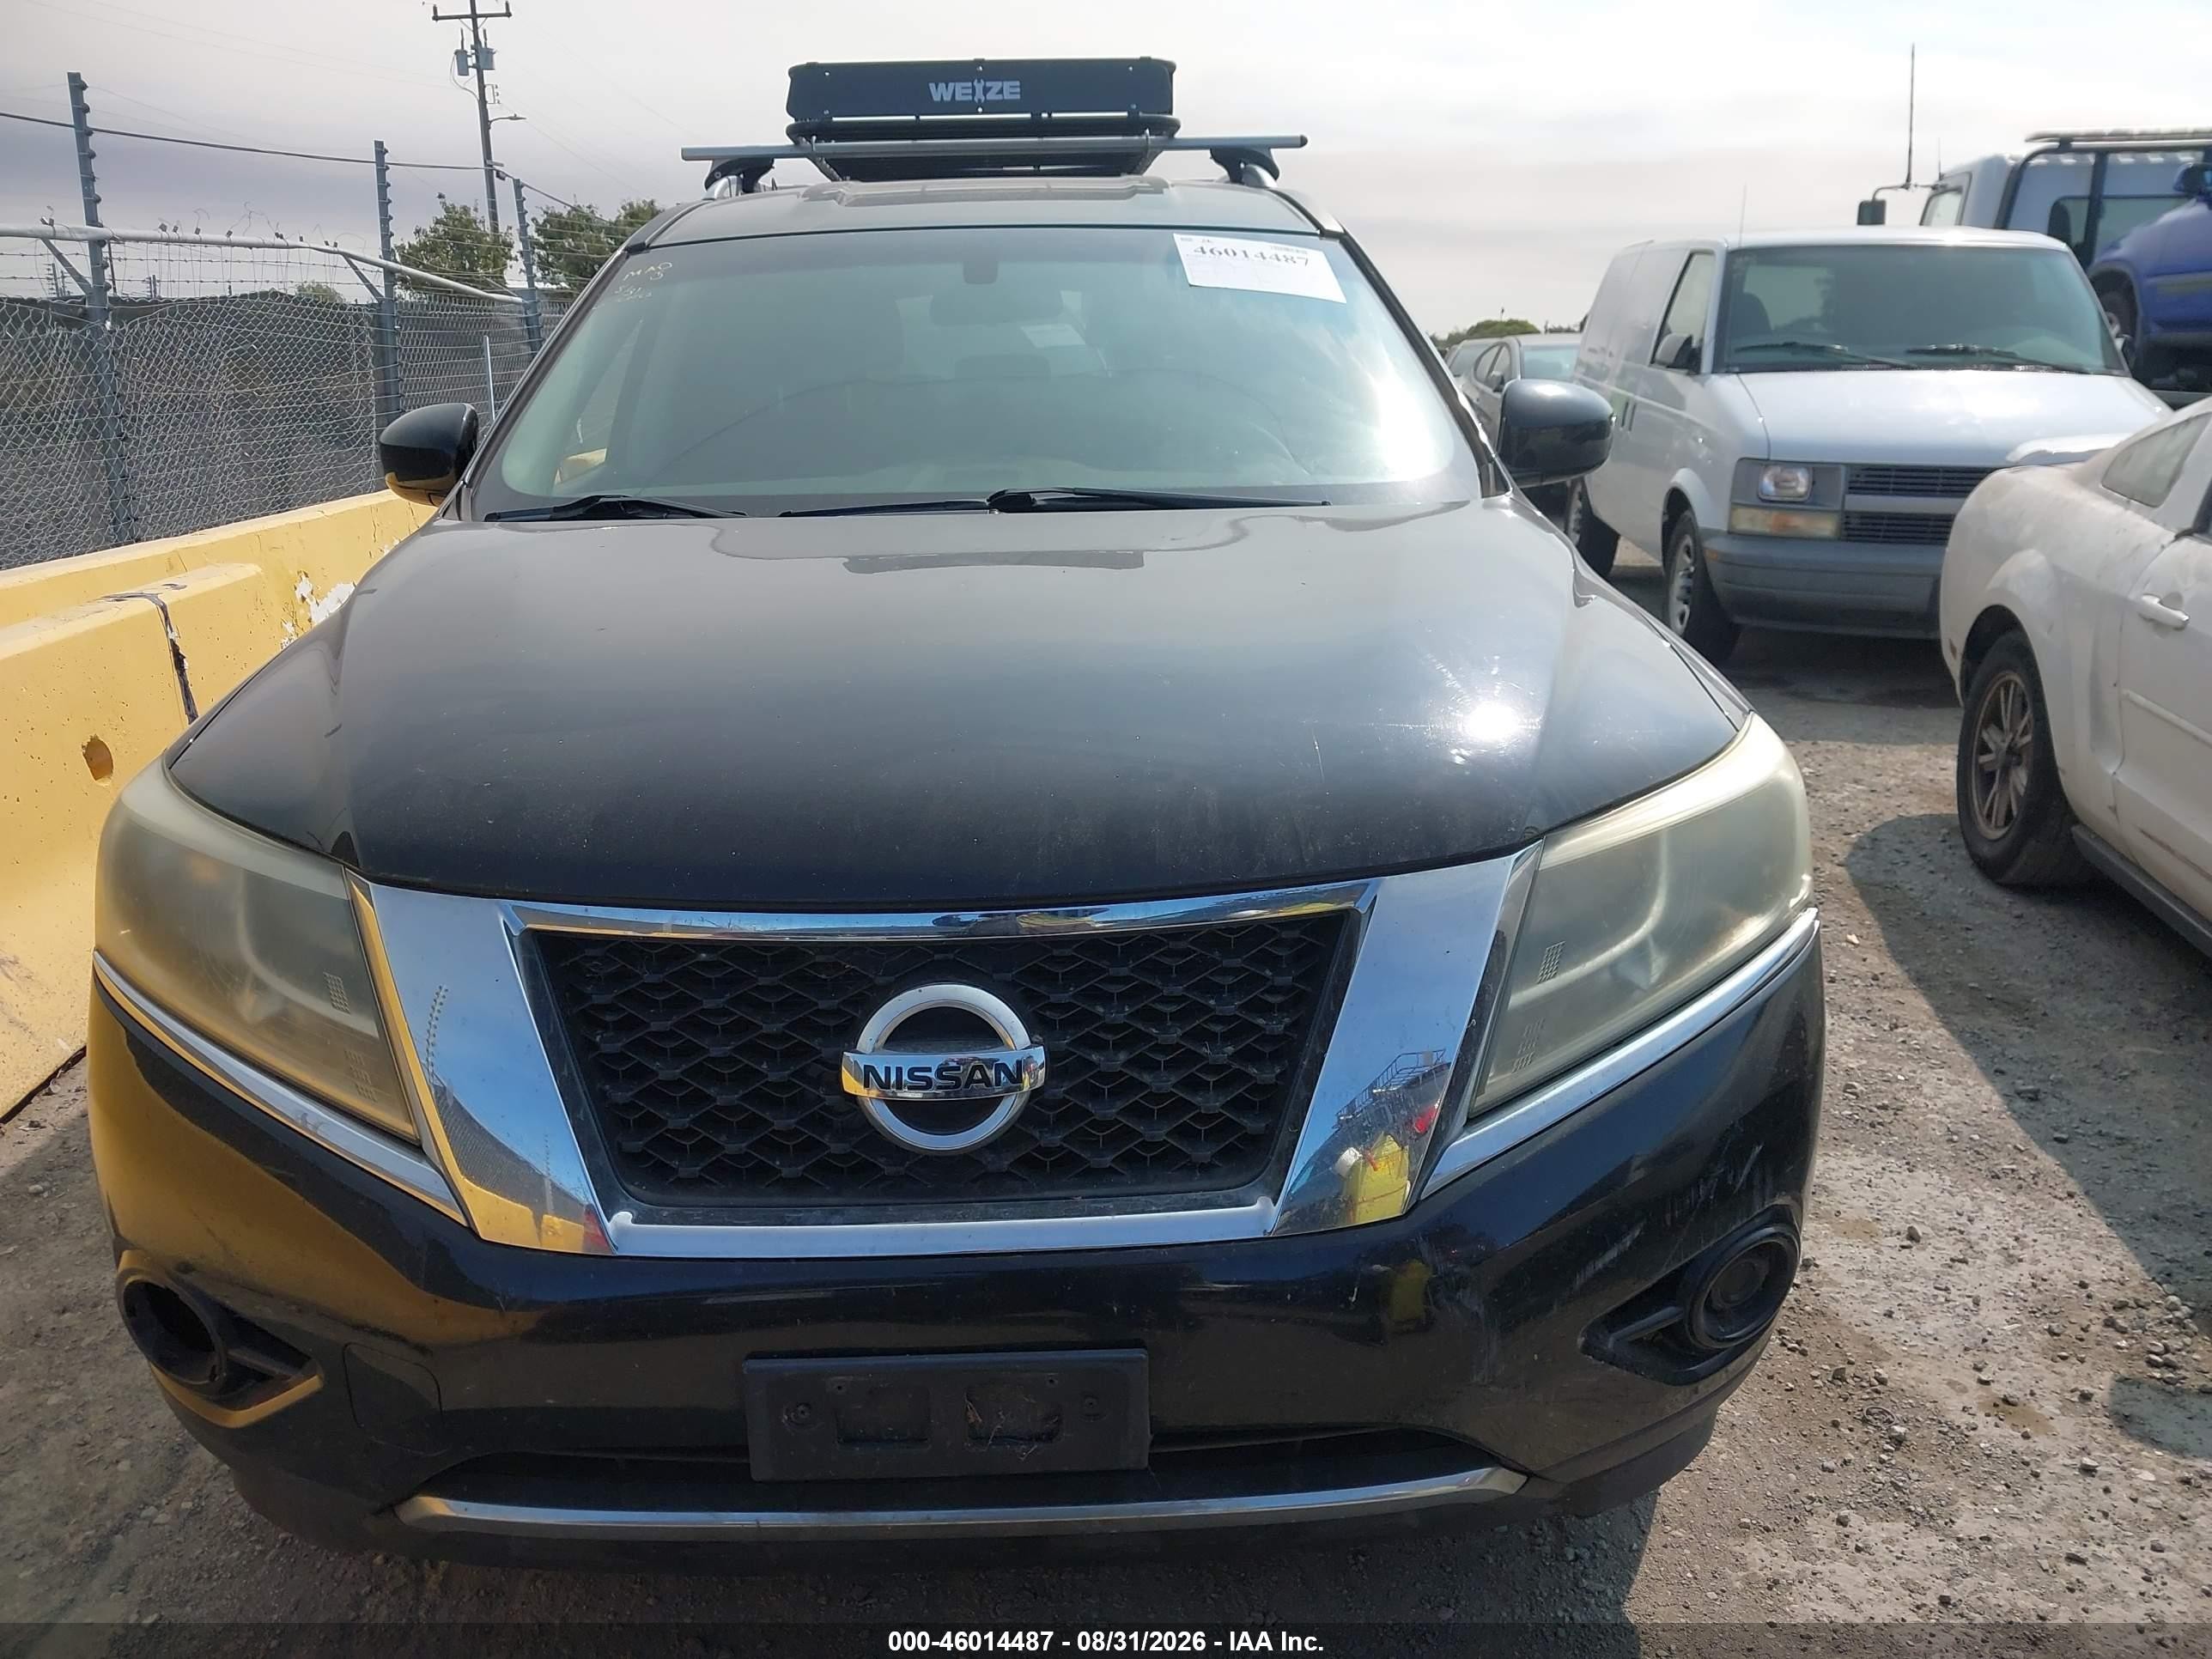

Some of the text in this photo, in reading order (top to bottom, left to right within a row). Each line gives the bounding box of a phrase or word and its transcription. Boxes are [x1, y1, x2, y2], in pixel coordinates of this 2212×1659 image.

[929, 79, 1021, 103] WEIZE
[1194, 246, 1310, 266] 46014487
[863, 1060, 1023, 1091] NISSAN
